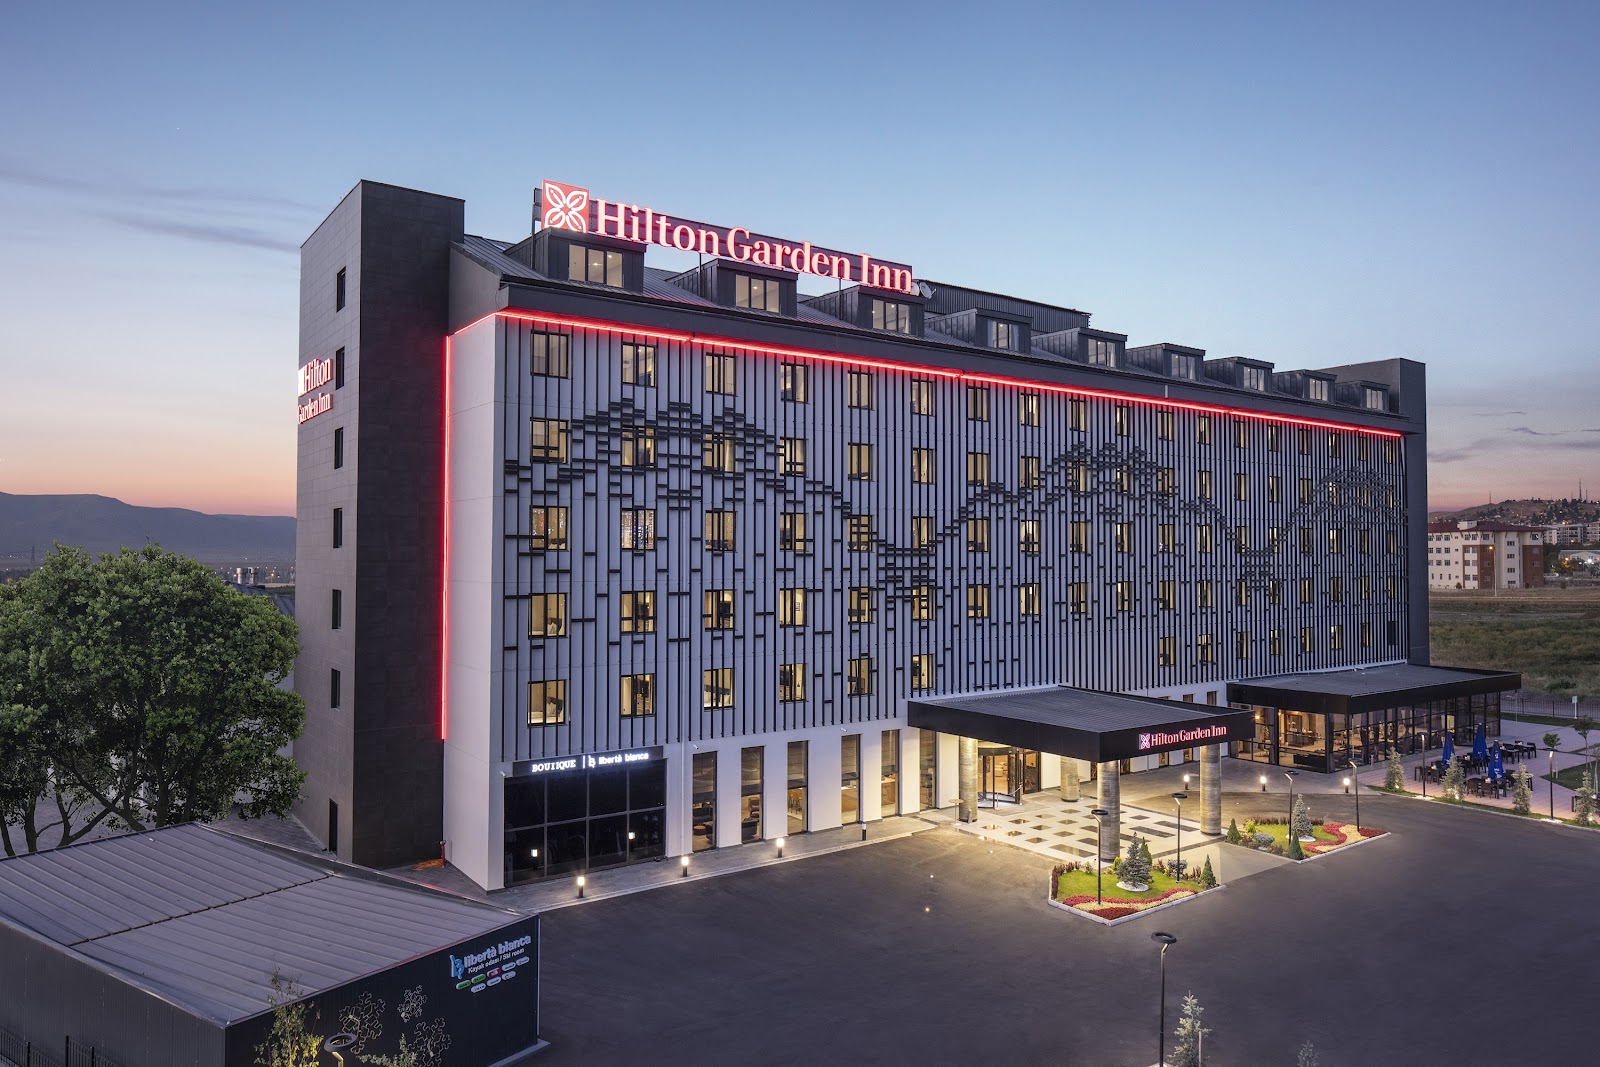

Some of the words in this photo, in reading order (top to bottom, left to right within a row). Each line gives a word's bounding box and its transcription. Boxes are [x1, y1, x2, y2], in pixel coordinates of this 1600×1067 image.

[595, 199, 720, 257] Hilton
[728, 227, 851, 282] Garden
[859, 253, 913, 293] Inn
[304, 358, 332, 392] Hilton
[297, 398, 318, 425] Garden
[318, 392, 332, 413] Inn
[1151, 733, 1179, 746] Hilton
[1180, 727, 1211, 742] Garden
[1212, 725, 1227, 736] Inn
[625, 752, 649, 762] bianca
[464, 946, 497, 968] libertà
[498, 935, 531, 954] bianca
